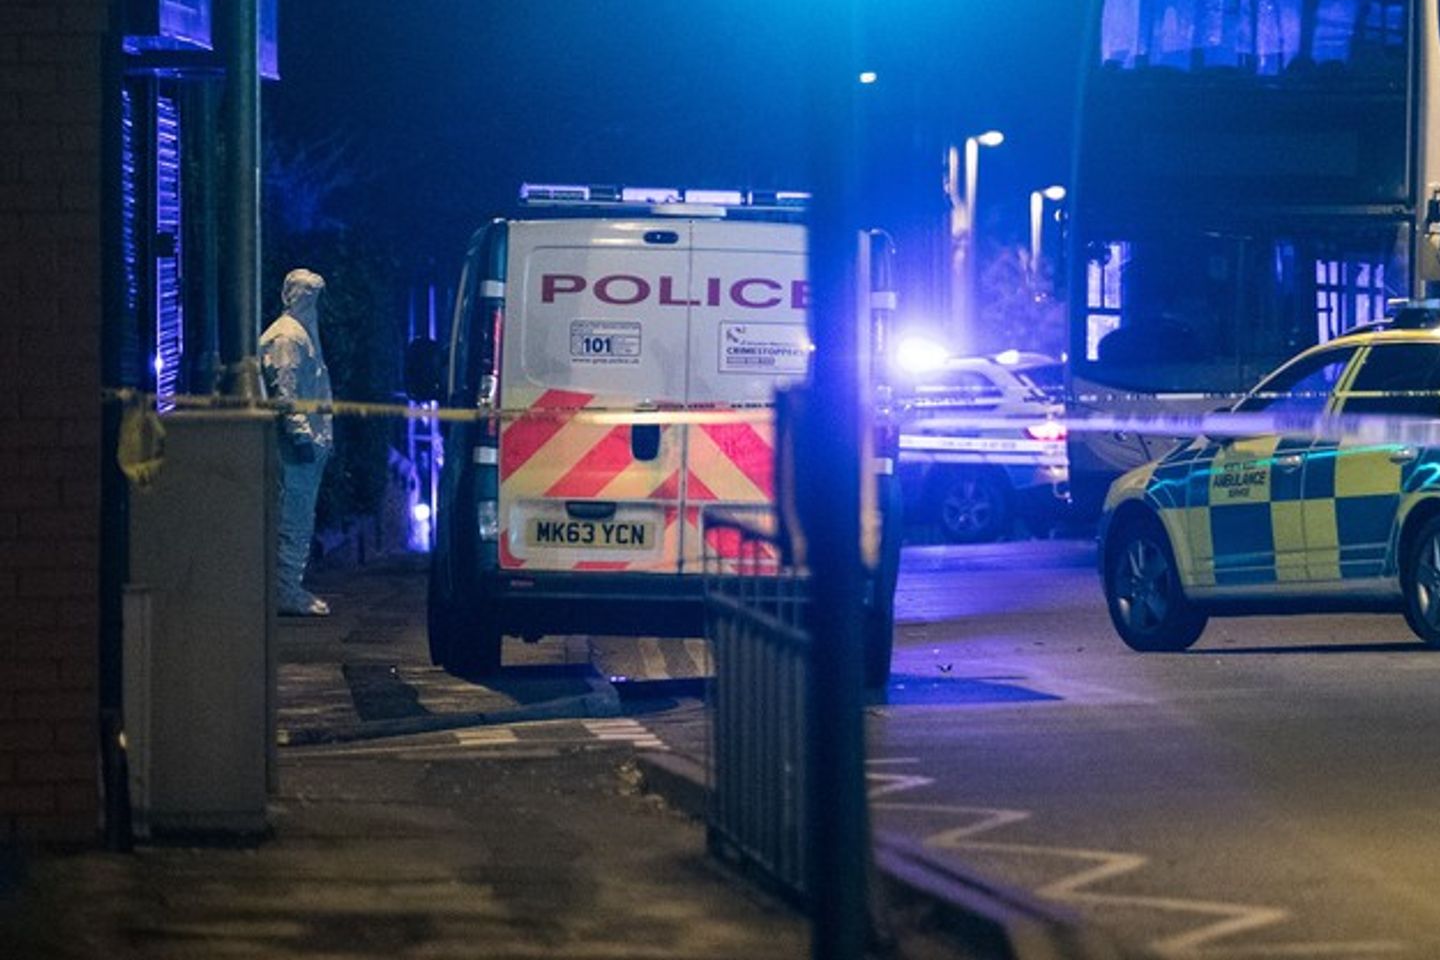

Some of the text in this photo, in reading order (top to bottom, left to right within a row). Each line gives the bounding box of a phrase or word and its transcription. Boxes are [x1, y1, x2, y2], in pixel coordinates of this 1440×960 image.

[583, 337, 612, 353] 101
[536, 522, 646, 544] MK63 YCN
